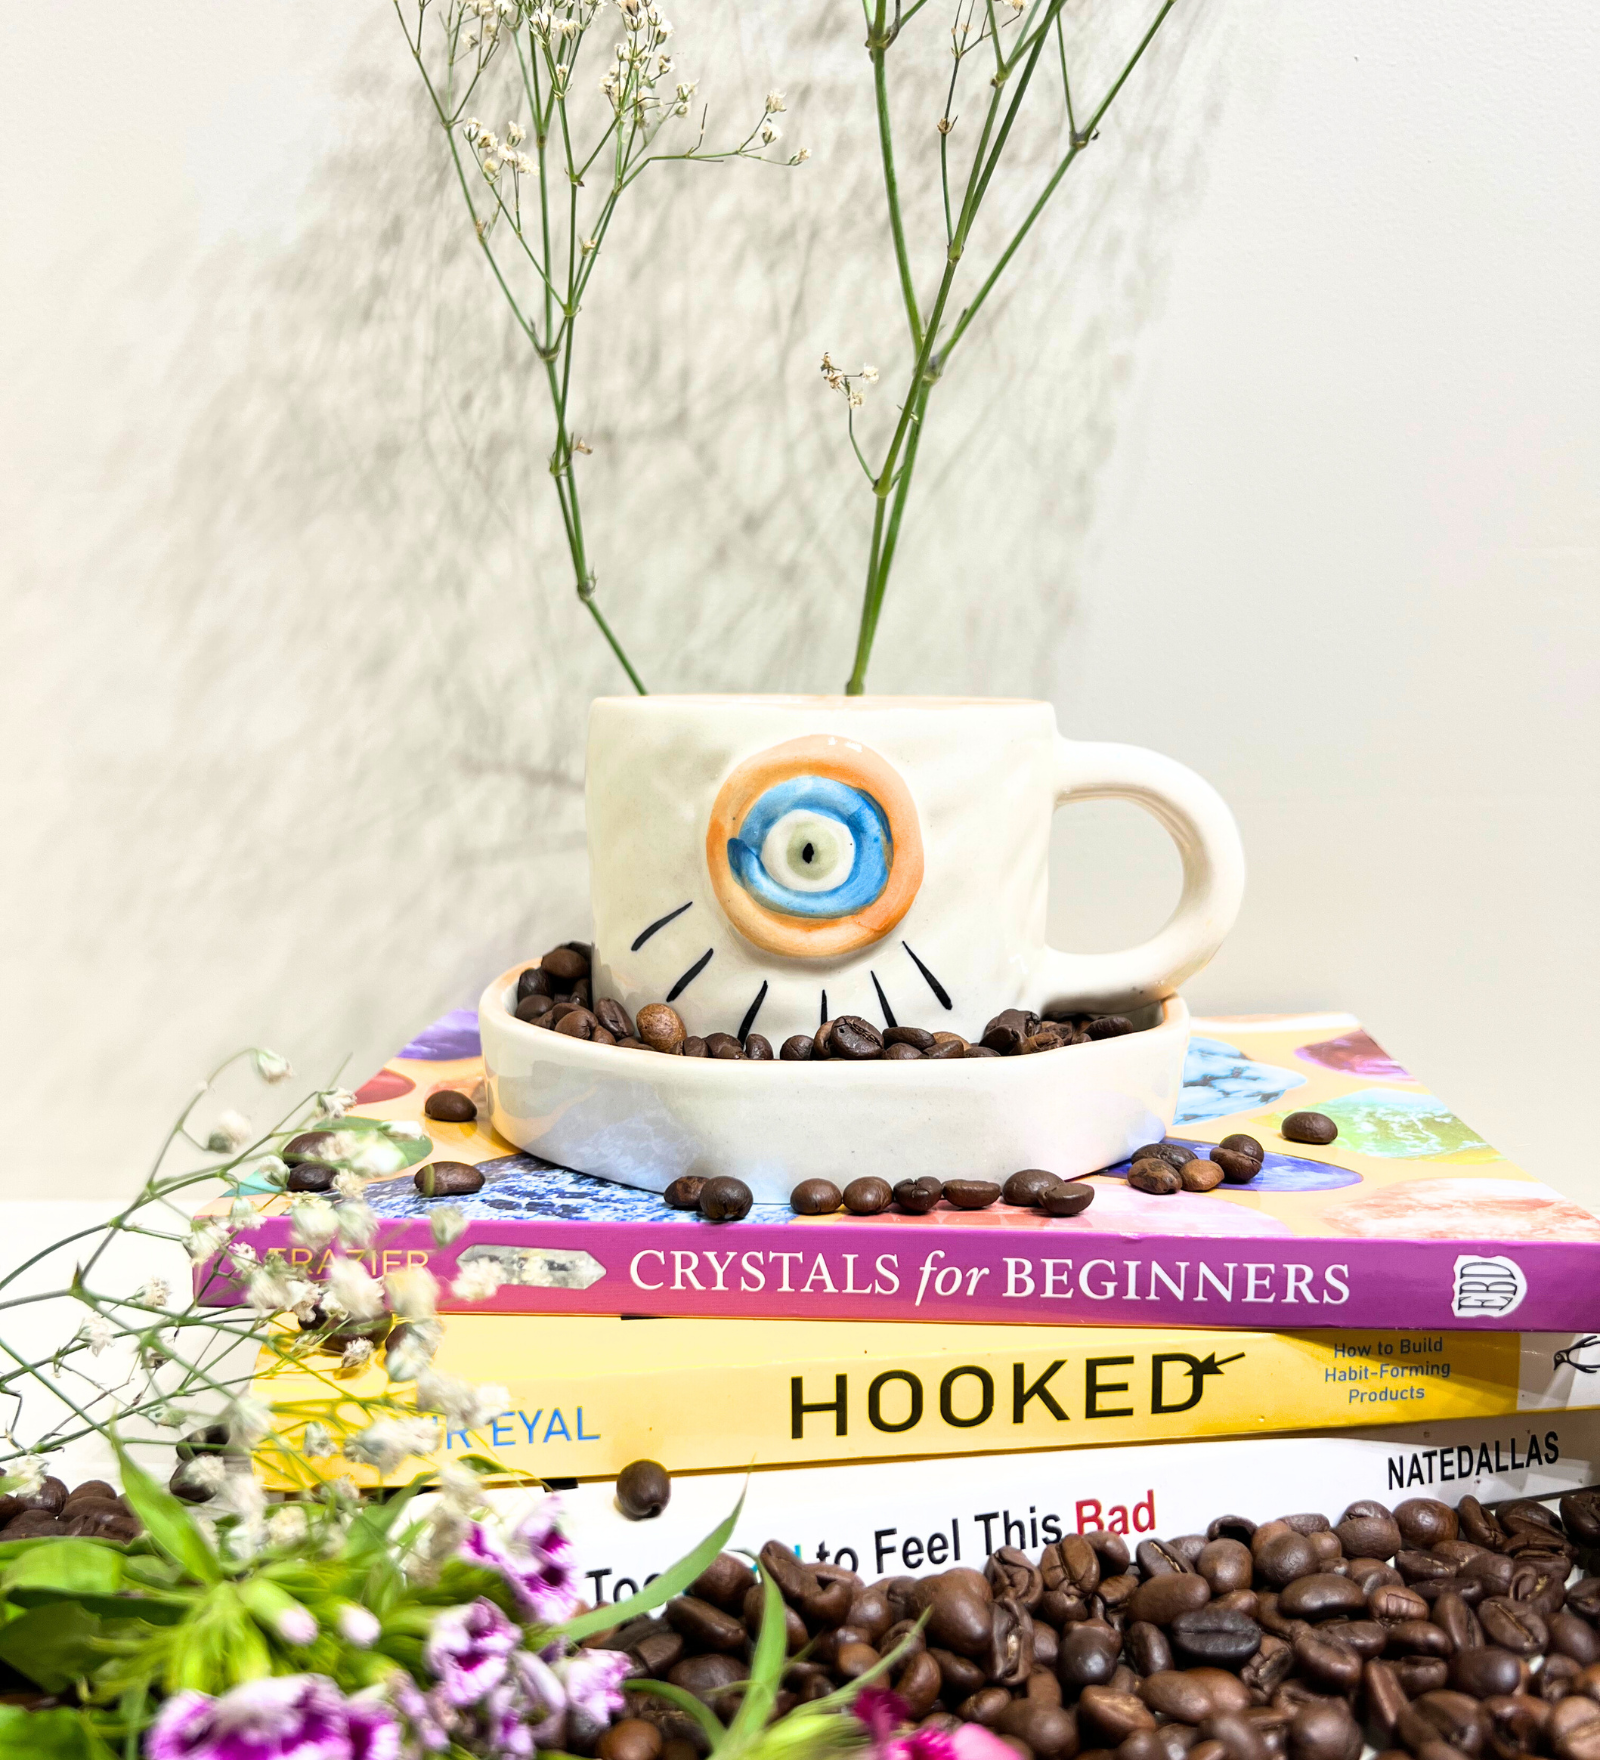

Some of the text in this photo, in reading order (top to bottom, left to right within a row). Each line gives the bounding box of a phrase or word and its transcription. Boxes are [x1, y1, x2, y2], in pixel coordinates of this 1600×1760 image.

[629, 1249, 1351, 1307] CRYSTALS for BEGINNERS
[1324, 1361, 1451, 1383] Habit-Forming
[1334, 1336, 1443, 1359] How to Build
[790, 1352, 1204, 1440] HOOKED
[1348, 1385, 1426, 1404] Products
[491, 1405, 602, 1447] EYAL
[1387, 1430, 1560, 1491] NATEDALLAS
[585, 1568, 661, 1603] To
[816, 1540, 859, 1573] to
[874, 1517, 962, 1574] Feel
[974, 1505, 1063, 1556] This
[1075, 1488, 1157, 1537] Bad
